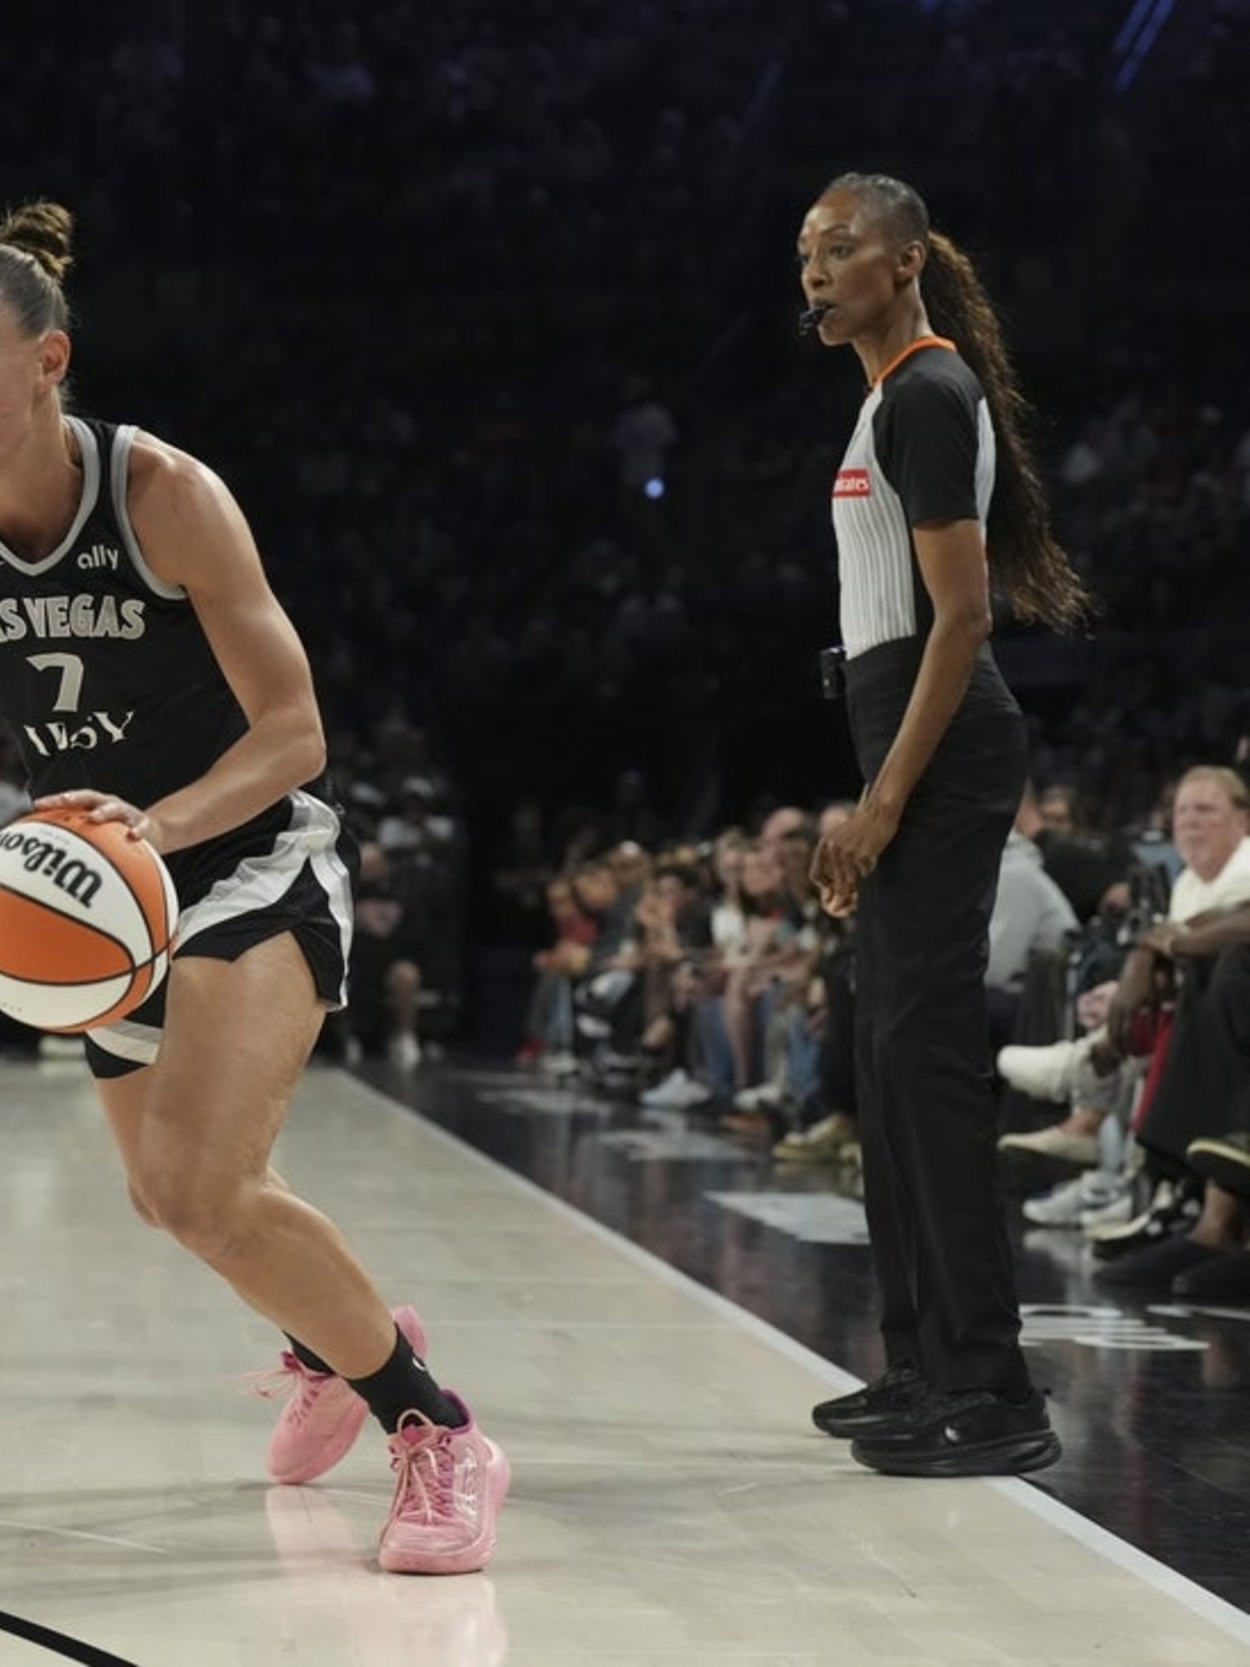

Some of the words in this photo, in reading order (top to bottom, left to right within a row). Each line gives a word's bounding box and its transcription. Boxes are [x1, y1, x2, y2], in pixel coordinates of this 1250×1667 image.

[77, 545, 119, 570] ally
[22, 593, 146, 640] VEGAS
[26, 652, 85, 713] 7
